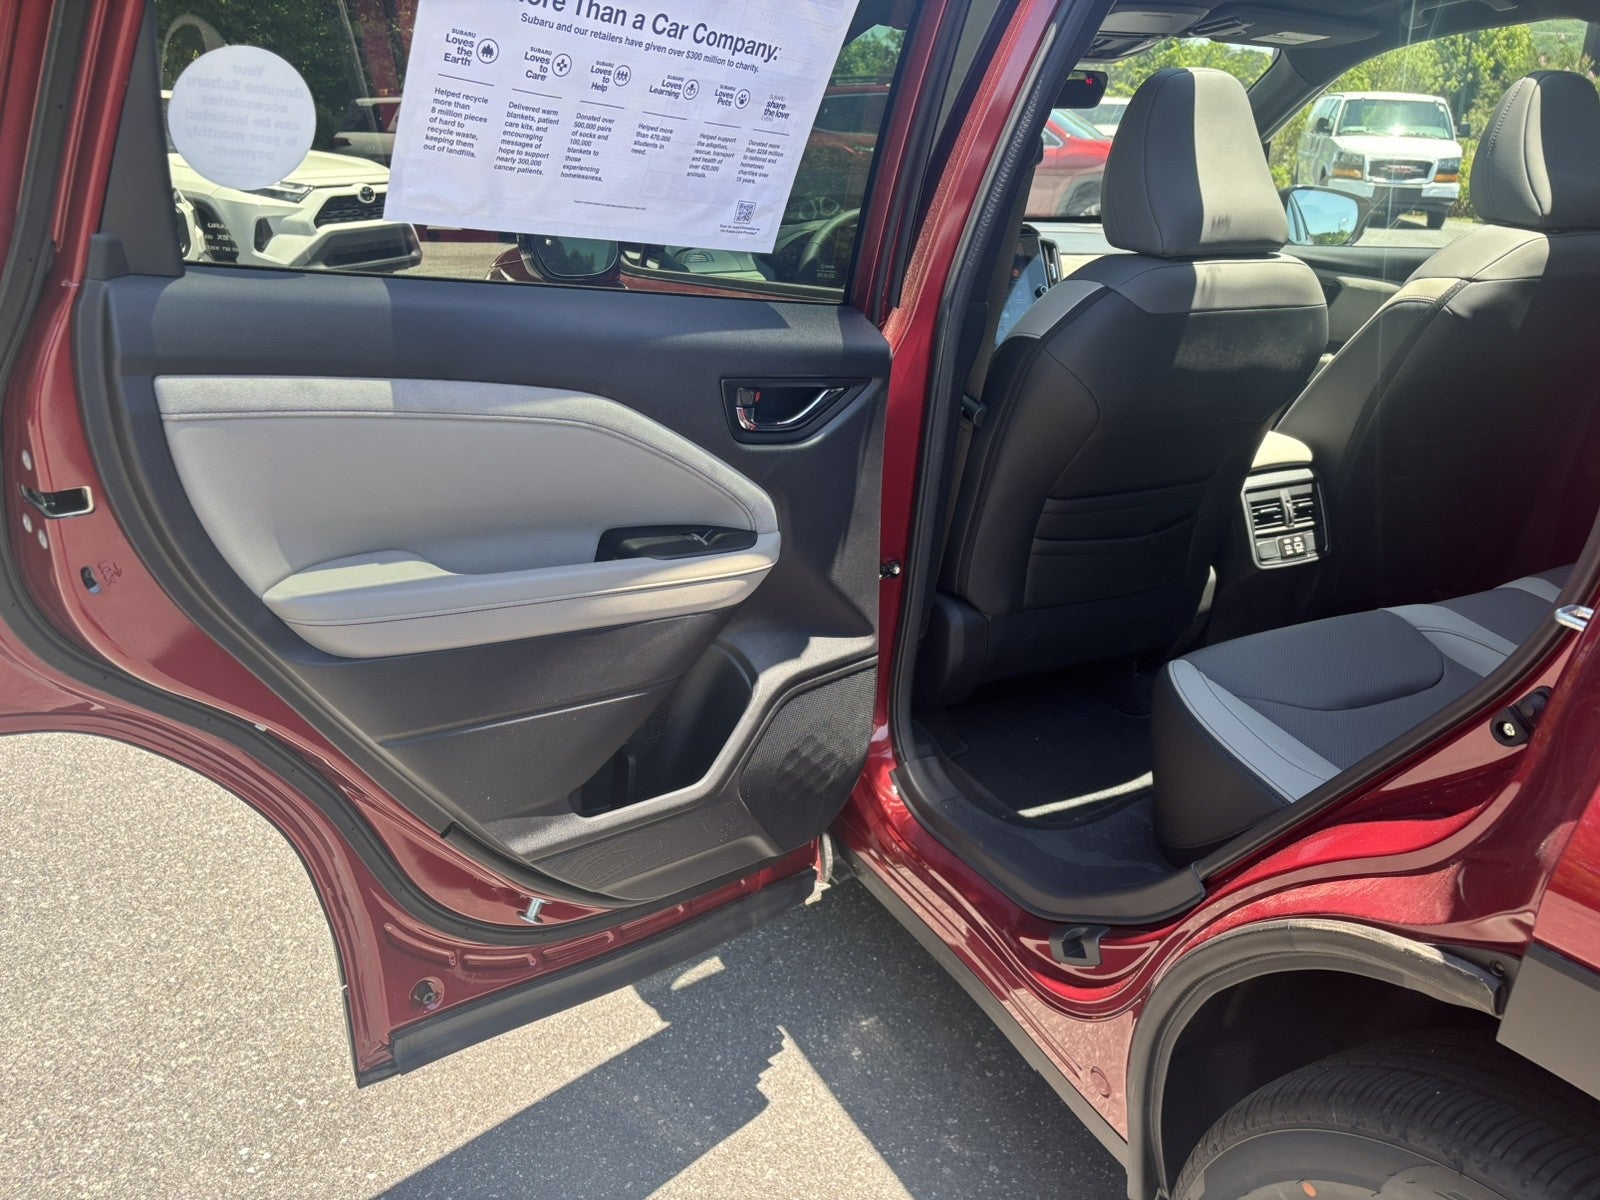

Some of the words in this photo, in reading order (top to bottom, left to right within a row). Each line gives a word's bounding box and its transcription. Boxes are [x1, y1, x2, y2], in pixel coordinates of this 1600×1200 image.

[575, 0, 628, 26] Than
[632, 13, 645, 30] a
[652, 14, 688, 40] Car
[451, 28, 476, 38] SUBARU
[445, 33, 474, 48] Loves
[520, 12, 554, 28] Subaru
[556, 23, 573, 33] and
[574, 27, 588, 36] our
[590, 30, 624, 44] retailers
[624, 34, 644, 48] have
[644, 42, 666, 54] given
[668, 47, 685, 58] over
[686, 50, 703, 62] $300
[703, 53, 726, 66] million
[726, 58, 734, 68] to
[735, 60, 760, 74] charity.
[456, 46, 473, 58] the
[530, 46, 553, 56] SUBARU
[443, 52, 472, 66] Earth
[524, 52, 550, 65] Loves
[539, 62, 548, 73] to
[590, 65, 612, 76] Loves
[525, 70, 547, 82] Care
[591, 82, 608, 92] Help
[661, 79, 682, 90] Loves
[434, 86, 461, 99] Helped
[462, 94, 489, 105] recycle
[649, 85, 681, 99] Learning
[714, 88, 734, 99] Loves
[432, 98, 452, 107] more
[454, 100, 470, 110] than
[508, 101, 541, 114] Delivered
[541, 108, 559, 116] warm
[717, 98, 732, 107] Pets
[766, 100, 786, 110] share
[437, 107, 462, 119] million
[464, 112, 488, 123] pieces
[506, 111, 536, 123] blankets,
[537, 117, 560, 126] patient
[576, 113, 601, 122] Donated
[764, 108, 775, 117] the
[775, 110, 790, 120] love
[429, 116, 438, 124] of
[438, 116, 456, 127] hard
[457, 120, 465, 129] to
[521, 122, 534, 132] kits,
[574, 121, 596, 130] 500,000
[638, 123, 659, 133] Helped
[427, 125, 454, 136] recycle
[456, 131, 479, 141] waste,
[502, 130, 543, 142] encouraging
[699, 133, 717, 141] Helped
[425, 134, 454, 146] keeping
[456, 139, 474, 148] them
[500, 138, 533, 150] messages
[633, 140, 658, 149] students
[423, 143, 436, 151] out
[437, 145, 446, 153] of
[446, 146, 477, 158] landfills.
[498, 146, 515, 156] hope
[524, 150, 549, 159] support
[567, 147, 592, 156] blankets
[496, 155, 516, 165] nearly
[517, 157, 542, 167] 300,000
[494, 164, 516, 172] cancer
[516, 167, 544, 176] patients.
[562, 164, 600, 174] experiencing
[560, 171, 603, 182] homelessness.
